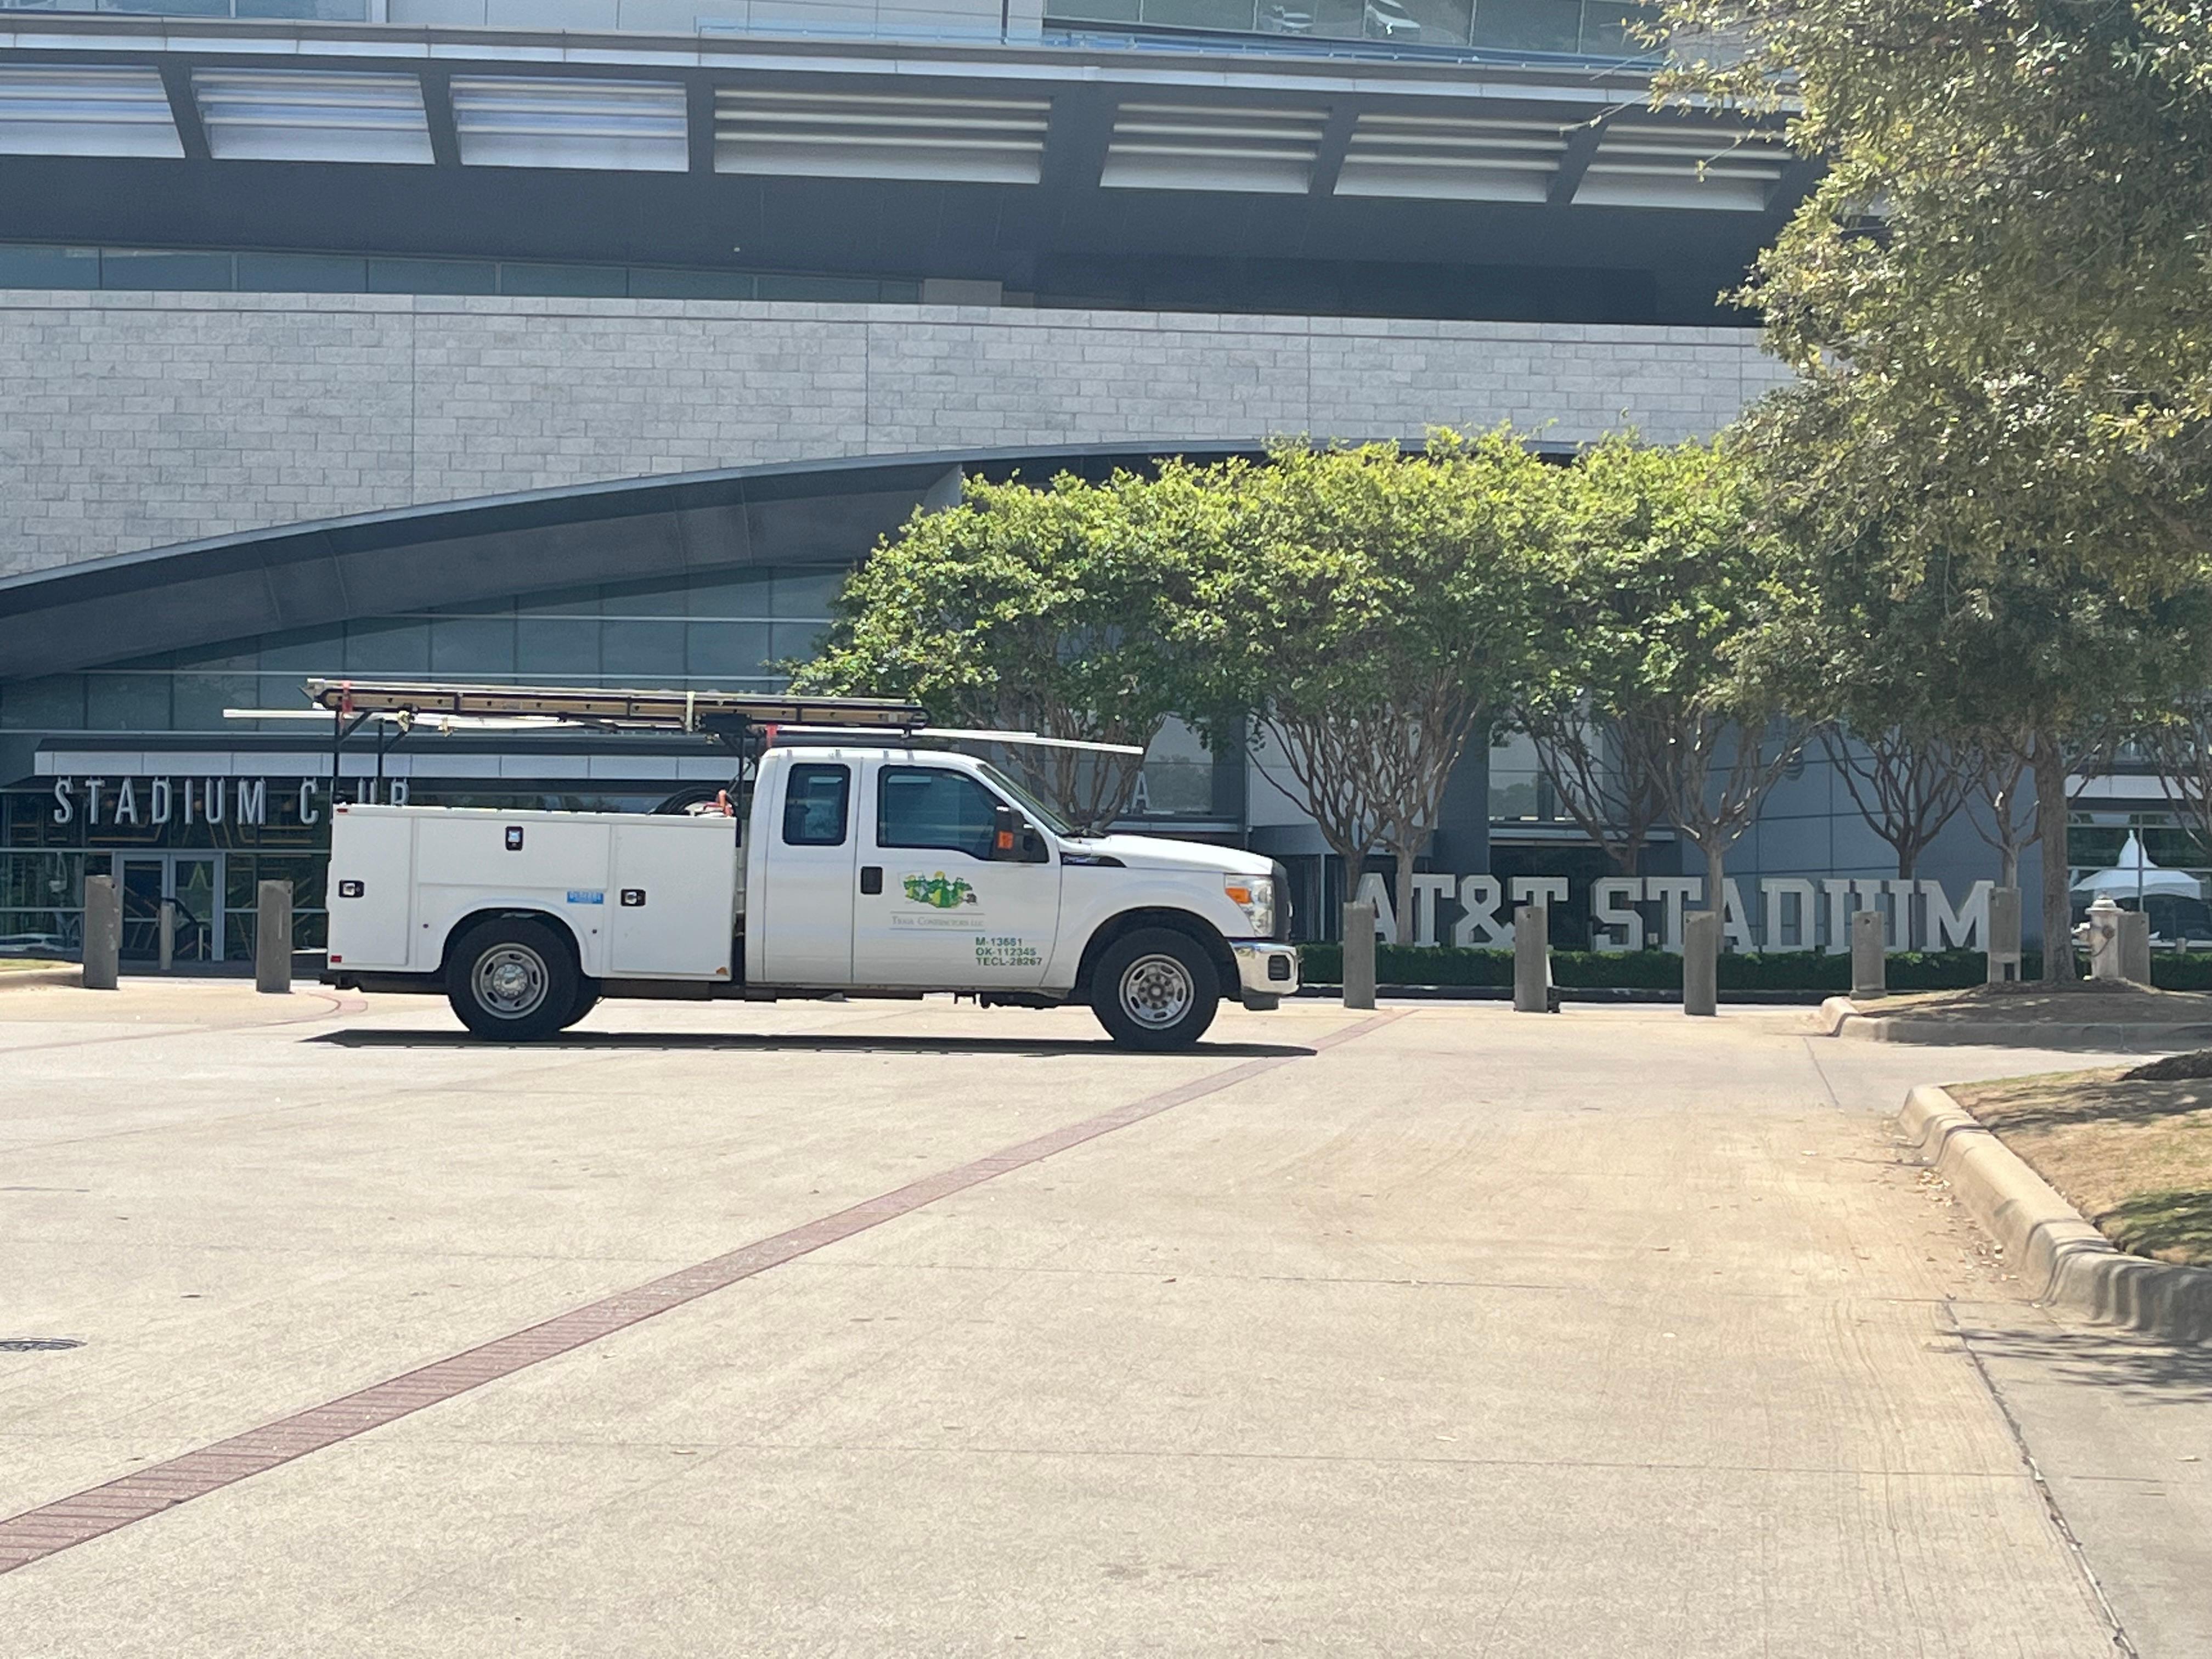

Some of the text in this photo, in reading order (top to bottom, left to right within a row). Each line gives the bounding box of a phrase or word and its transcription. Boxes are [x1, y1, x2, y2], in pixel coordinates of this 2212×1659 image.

[54, 779, 267, 825] STADIUM
[1340, 872, 1995, 953] AT&T STADIUM
